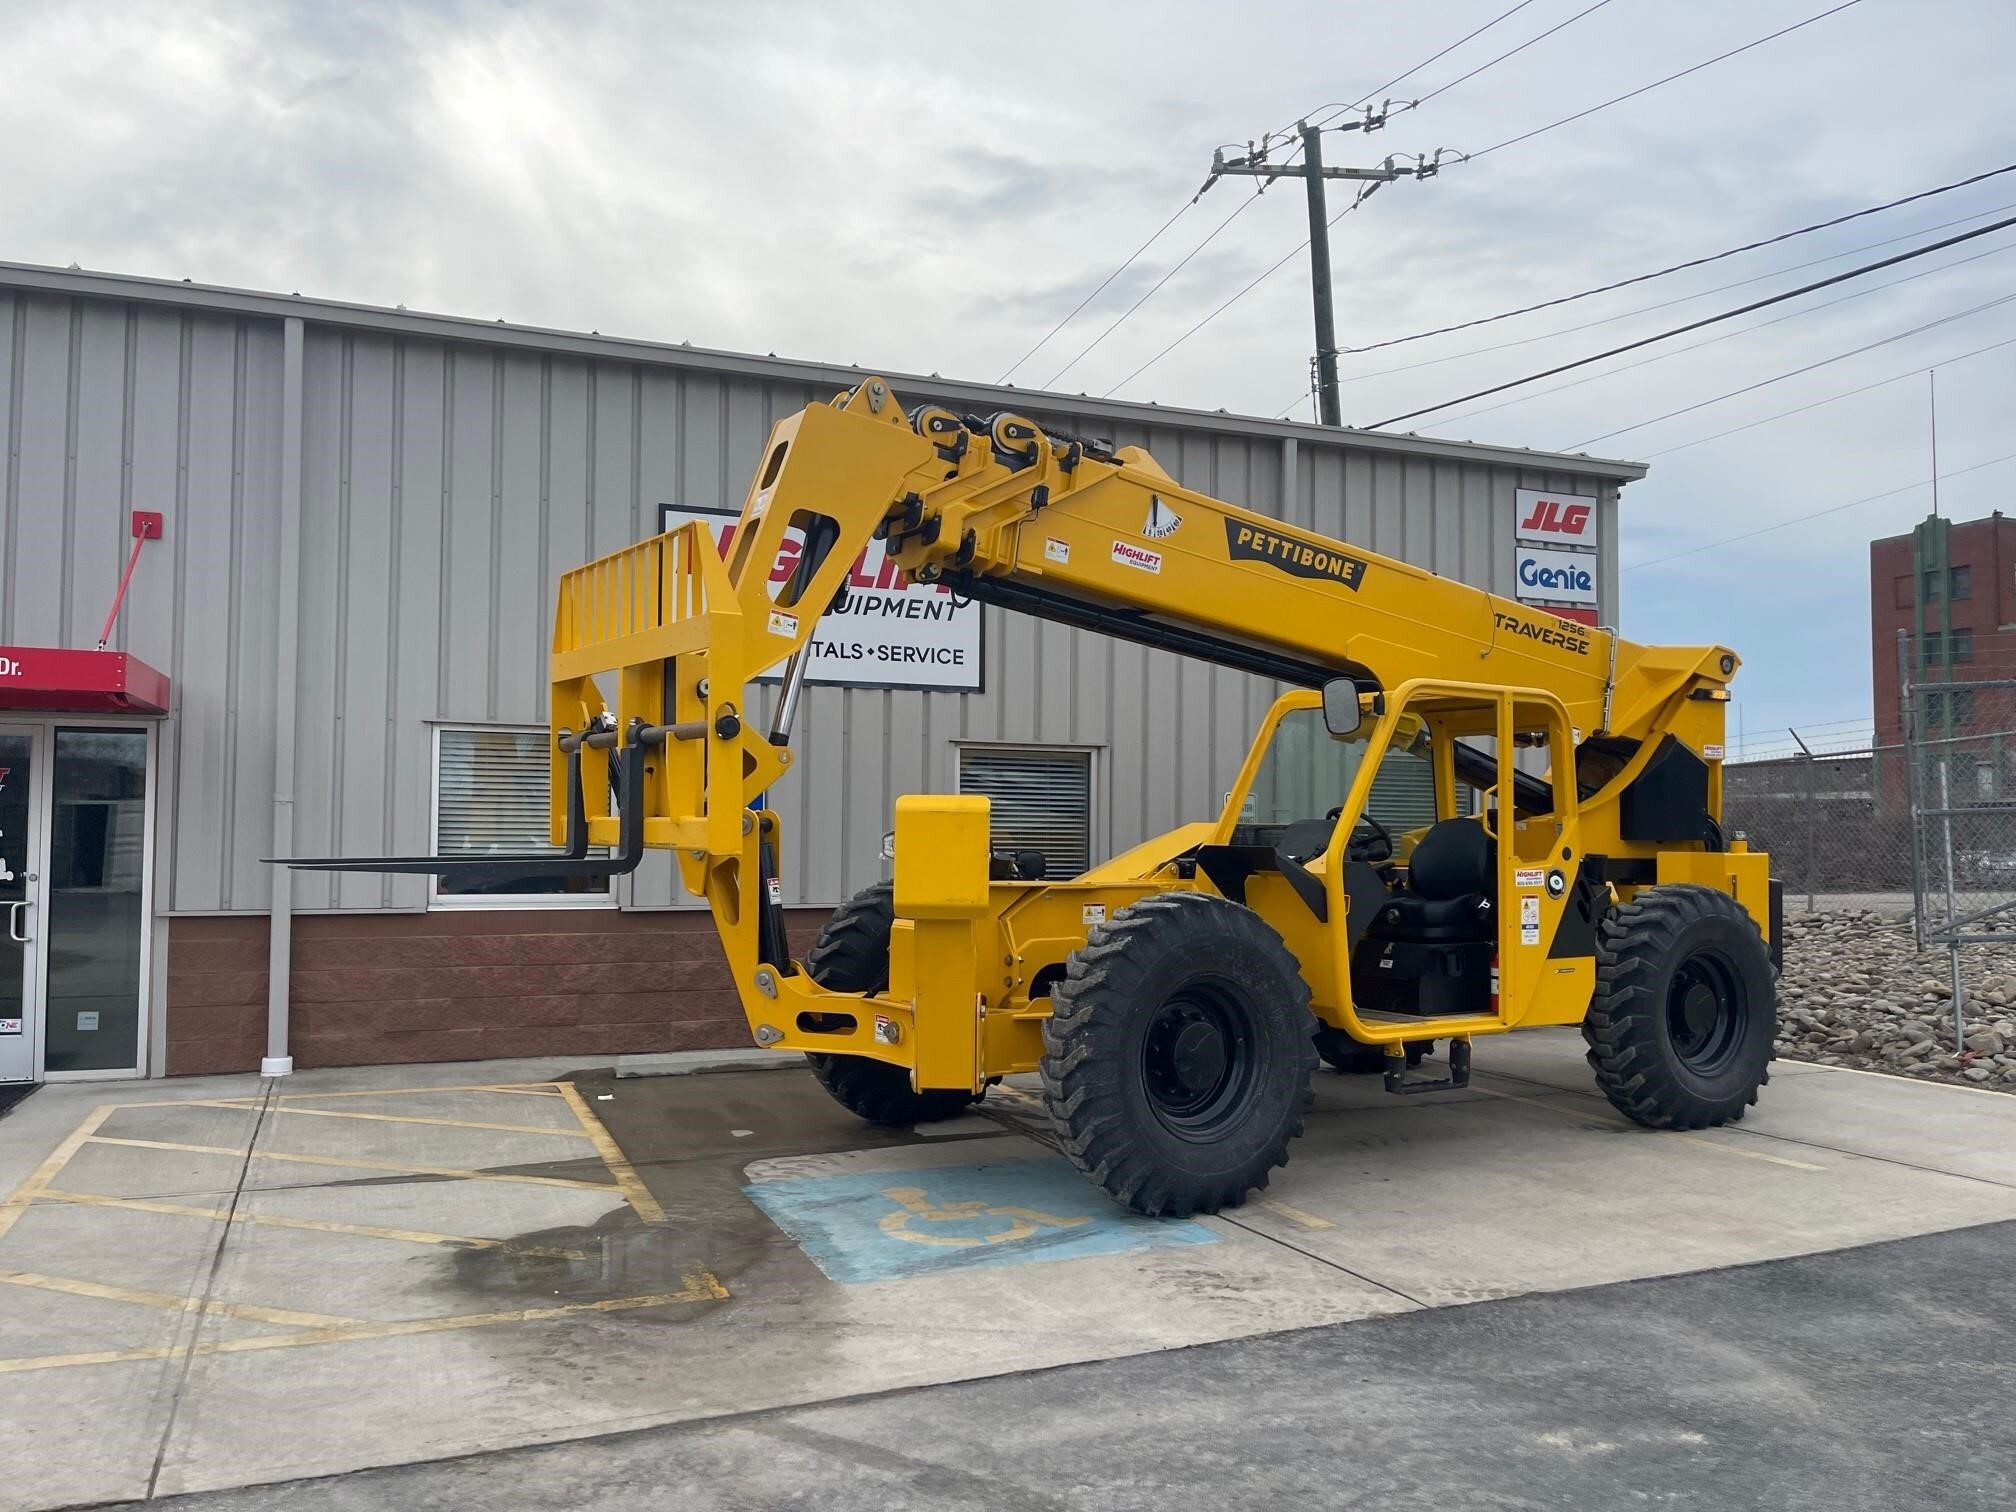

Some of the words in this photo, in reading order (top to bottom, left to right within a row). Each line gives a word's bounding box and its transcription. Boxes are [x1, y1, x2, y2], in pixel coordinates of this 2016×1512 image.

[1522, 501, 1591, 535] JLG
[1113, 542, 1161, 566] HIGHLIFT
[1129, 559, 1158, 572] EQUIPMENT
[1237, 527, 1355, 580] PETTIBONE
[1519, 558, 1592, 591] Genie
[1494, 612, 1591, 656] TRAVERSE
[0, 656, 22, 676] Dr.
[877, 644, 964, 665] SERVICE
